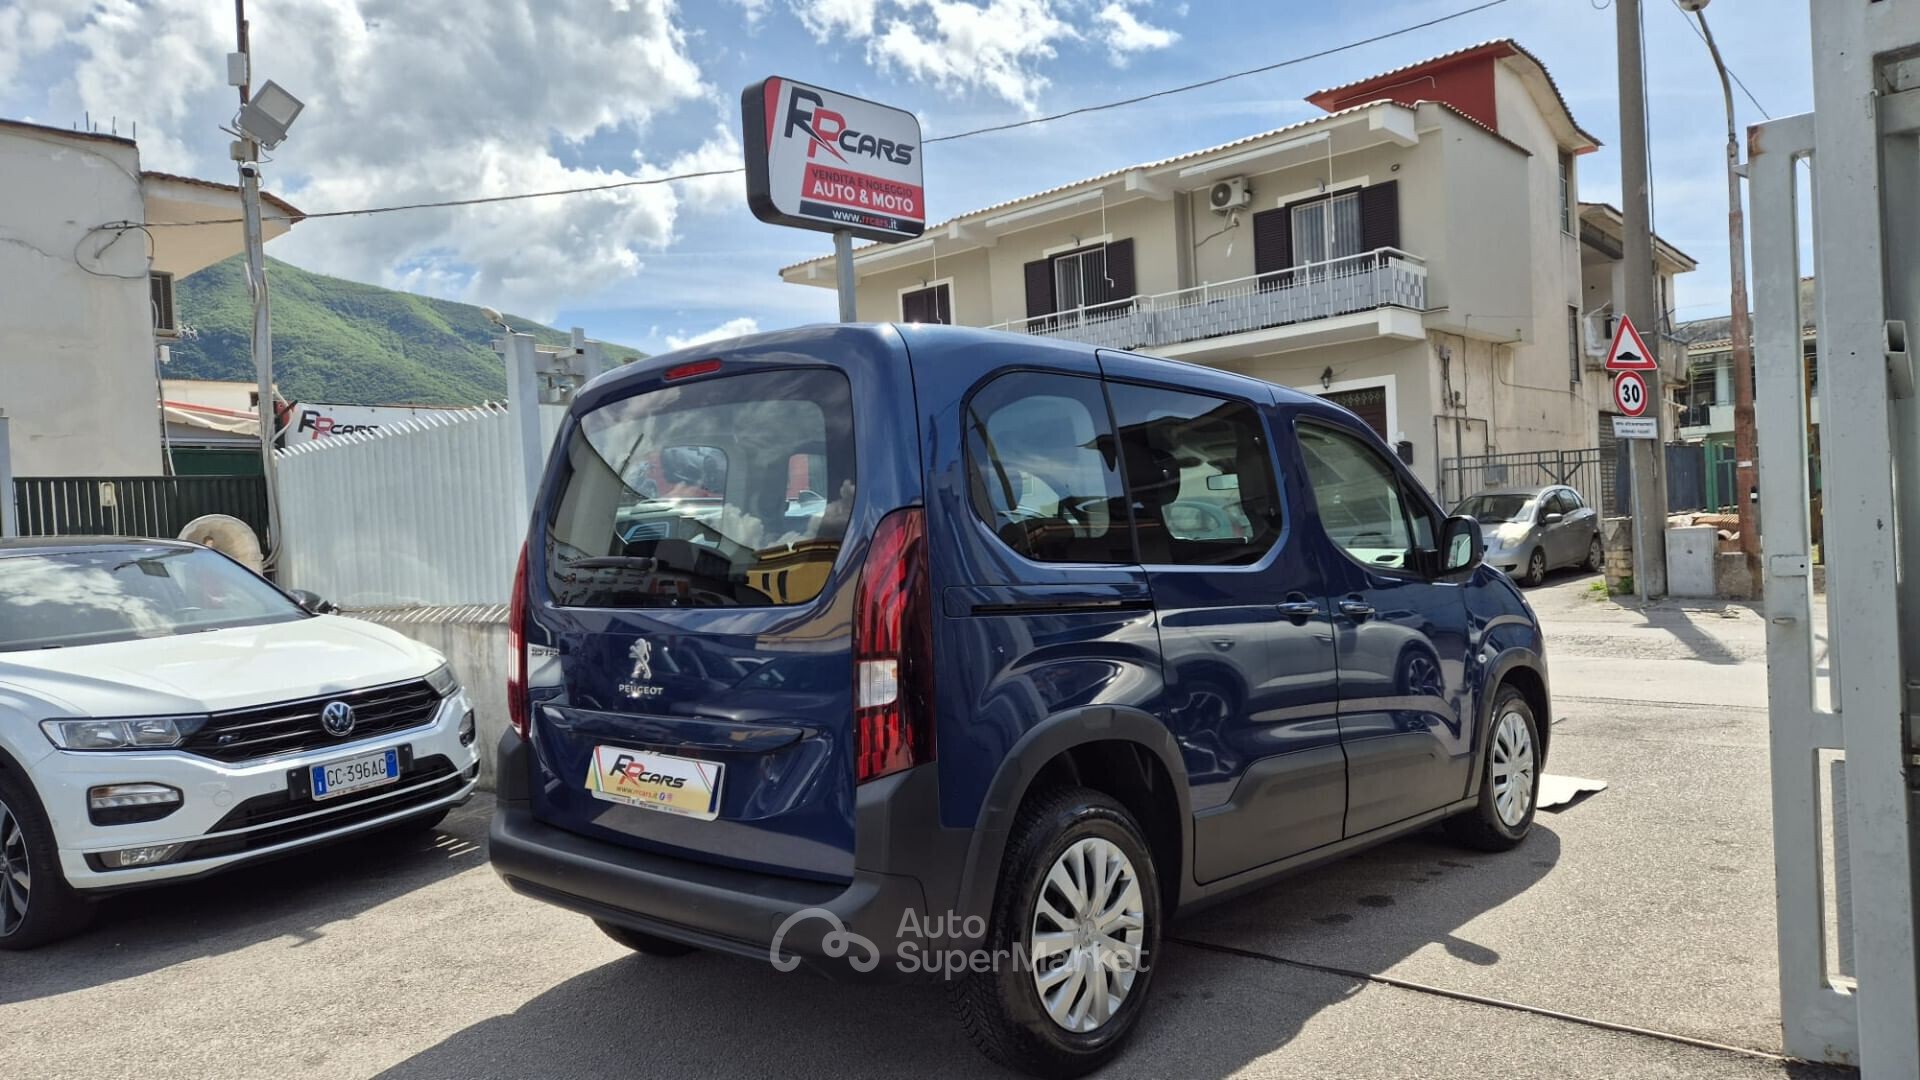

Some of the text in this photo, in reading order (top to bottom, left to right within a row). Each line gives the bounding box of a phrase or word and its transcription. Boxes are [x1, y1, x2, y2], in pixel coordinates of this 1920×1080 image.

[838, 129, 915, 166] CARS
[812, 168, 913, 197] VENDITA E NOLEGGIO
[813, 180, 914, 212] AUTO & MOTO
[832, 210, 898, 230] www.rrcars.it
[1622, 384, 1640, 404] 30
[618, 683, 664, 696] PEUGEOT
[637, 771, 688, 789] CARS
